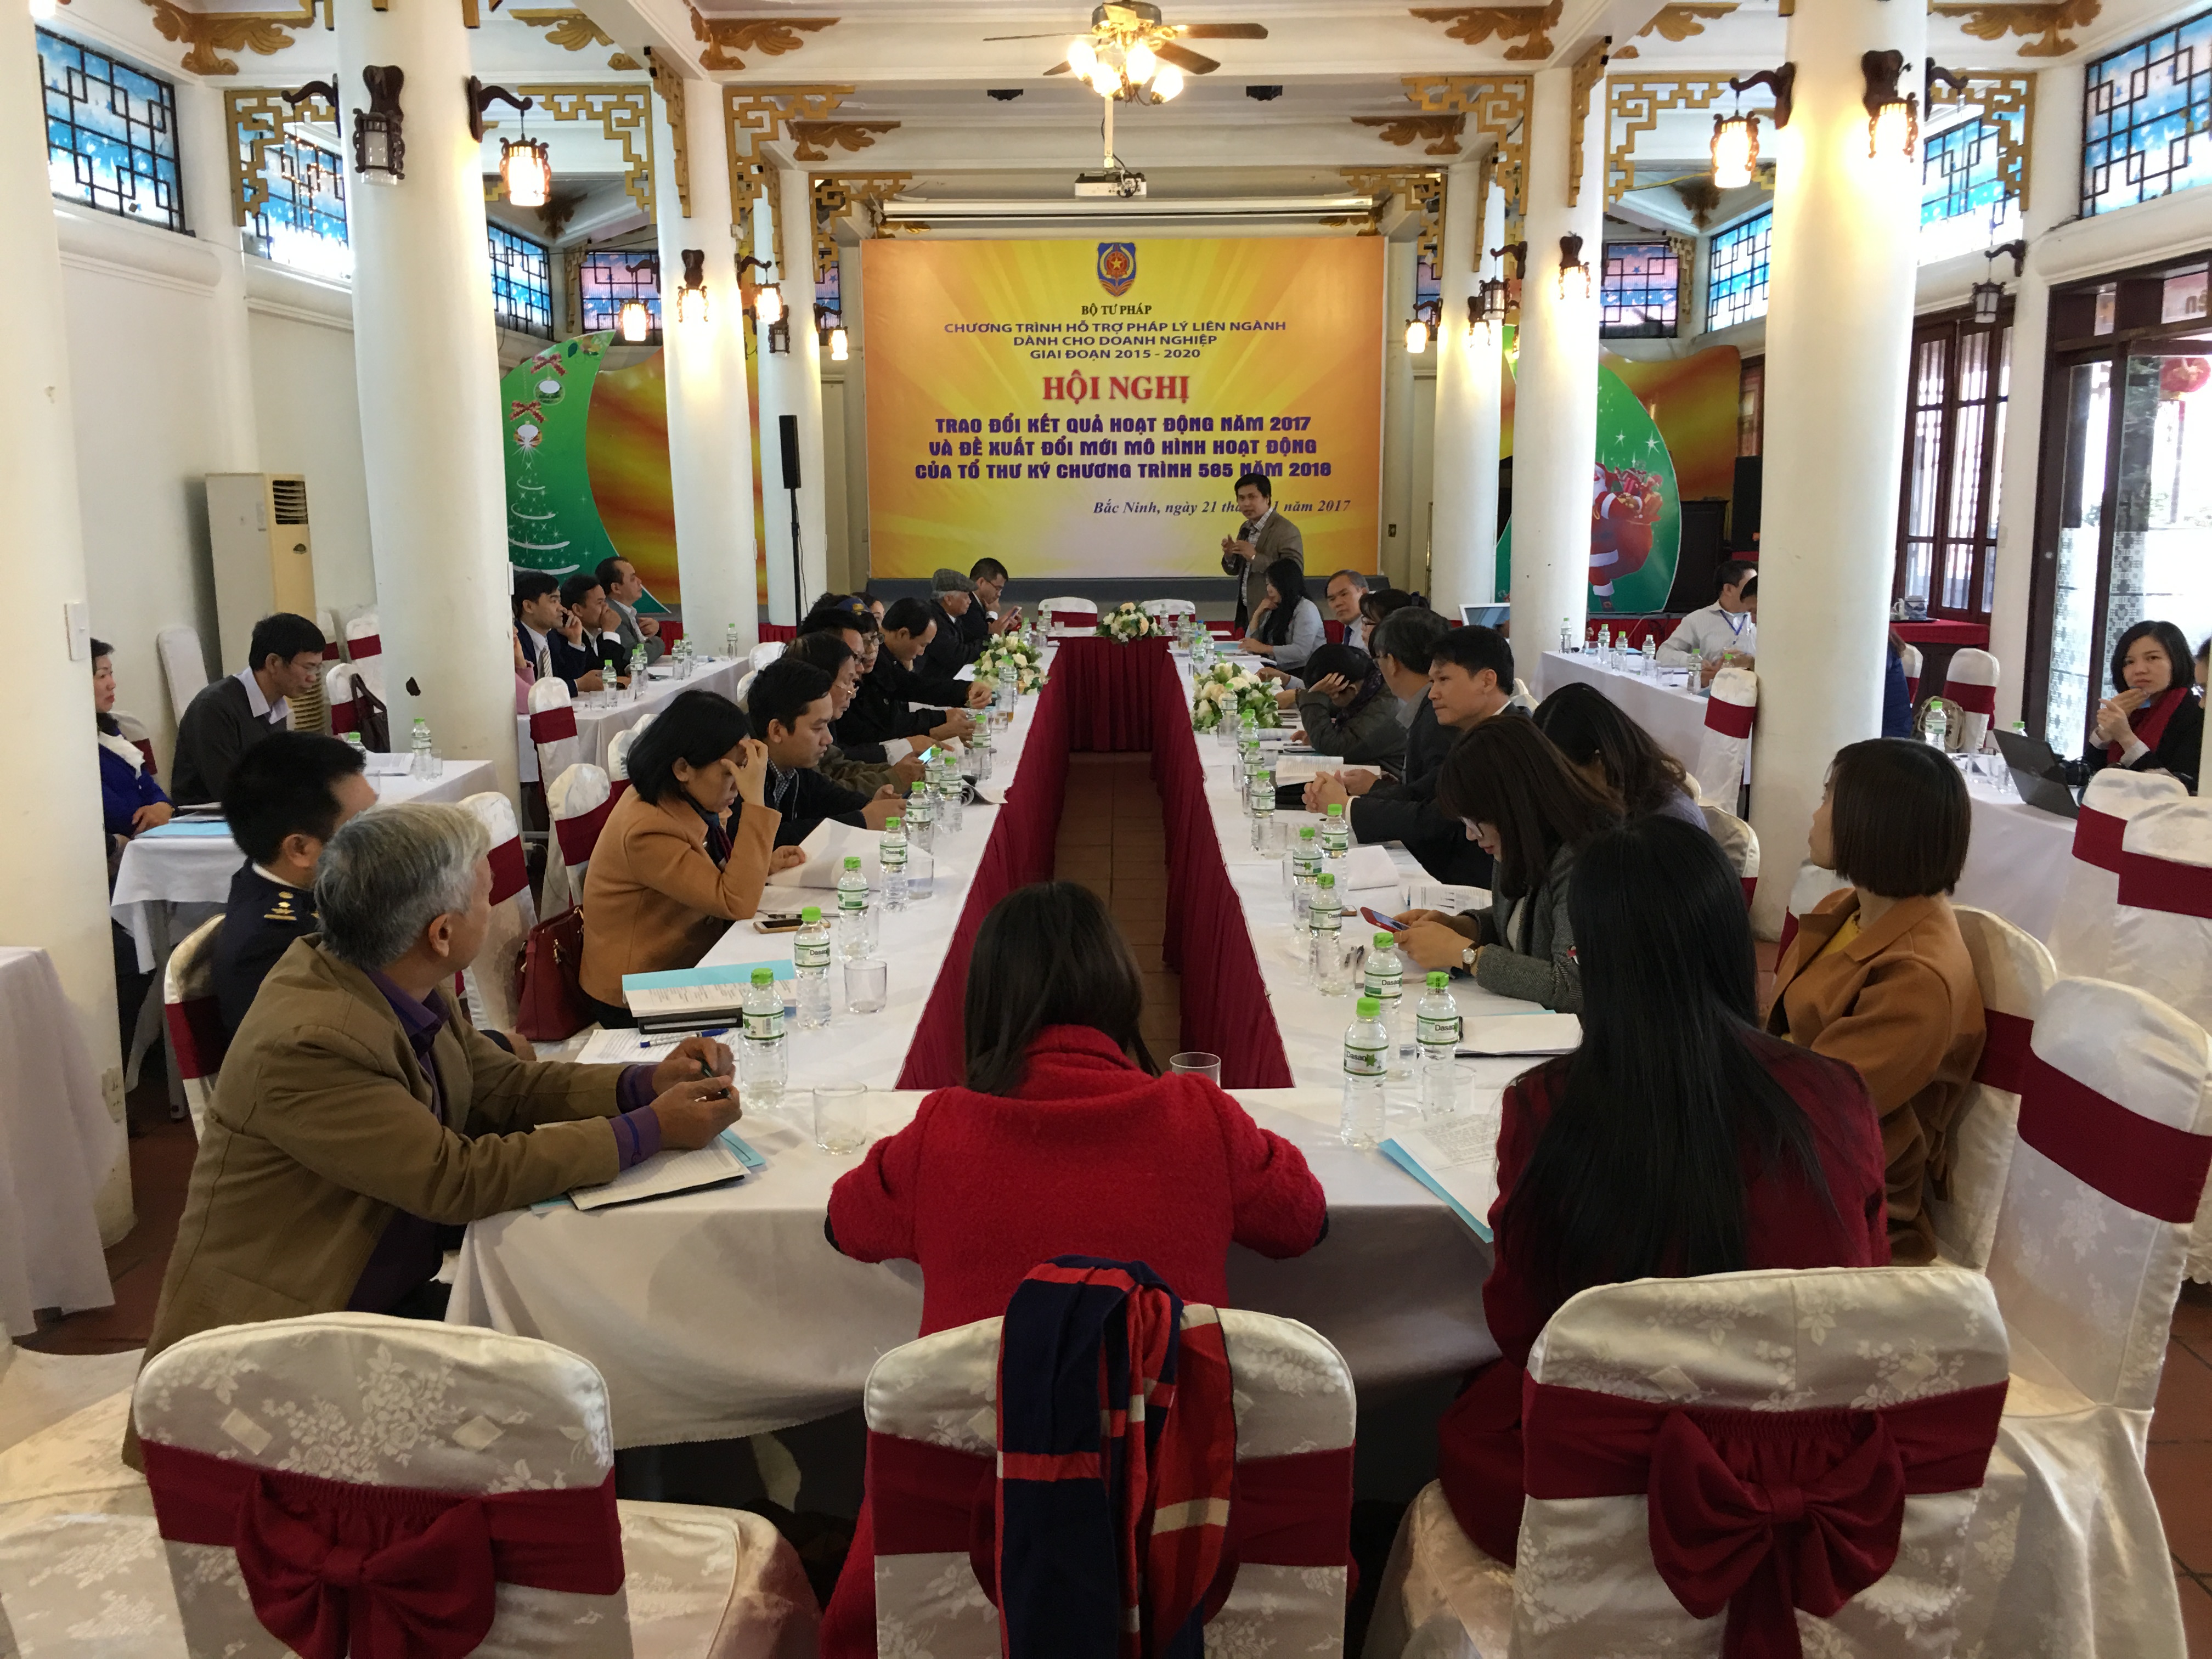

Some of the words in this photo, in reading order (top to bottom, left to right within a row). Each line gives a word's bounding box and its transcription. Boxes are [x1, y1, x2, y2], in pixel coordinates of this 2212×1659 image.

[1081, 302, 1098, 317] BỘ
[1101, 303, 1118, 315] TƯ
[1120, 302, 1152, 315] PHÁP
[944, 322, 1012, 333] CHƯƠNG
[1015, 321, 1062, 332] TRÌNH
[1066, 320, 1089, 332] HỖ
[1092, 322, 1124, 335] TRỢ
[1127, 321, 1168, 332] PHÁP
[1172, 320, 1188, 332] LÝ
[1193, 320, 1226, 331] LIÊN
[1230, 320, 1286, 331] NGÀNH
[1013, 335, 1058, 346] DÀNH
[1062, 336, 1095, 346] CHO
[1099, 336, 1155, 346] DOANH
[1160, 334, 1217, 347] NGHIỆP
[1030, 349, 1061, 359] GIAI
[1065, 349, 1110, 362] ĐOẠN
[1115, 349, 1151, 359] 2015
[1164, 349, 1200, 358] 2020
[1042, 369, 1100, 405] HỘI
[1109, 376, 1189, 404] NGHỊ
[935, 418, 982, 433] TRAO
[988, 412, 1020, 433] ĐỔI
[1028, 413, 1060, 433] KẾT
[1066, 414, 1103, 434] QUẢ
[1110, 417, 1157, 436] HOẠT
[1163, 414, 1214, 435] ĐỘNG
[1221, 414, 1263, 432] NĂM
[1269, 416, 1311, 431] 2017
[929, 438, 953, 456] VÀ
[958, 436, 983, 456] ĐỀ
[989, 436, 1035, 456] XUẤT
[1041, 435, 1073, 456] ĐỔI
[1080, 438, 1117, 456] MỚI
[1124, 438, 1155, 455] MÔ
[1162, 437, 1206, 455] HÌNH
[1212, 439, 1260, 458] HOẠT
[1265, 436, 1317, 457] ĐỘNG
[915, 460, 952, 479] CỦA
[957, 458, 980, 479] TỔ
[986, 463, 1022, 479] THƯ
[1028, 461, 1051, 479] KÝ
[1056, 462, 1131, 479] CHƯƠNG
[1137, 460, 1192, 478] TRÌNH
[1240, 460, 1283, 477] NĂM
[1289, 462, 1331, 477] 2018
[1093, 499, 1119, 514] Bắc
[1165, 501, 1198, 516] ngày
[1201, 501, 1217, 513] 21
[1283, 501, 1313, 512] năm
[1317, 500, 1351, 512] 2017
